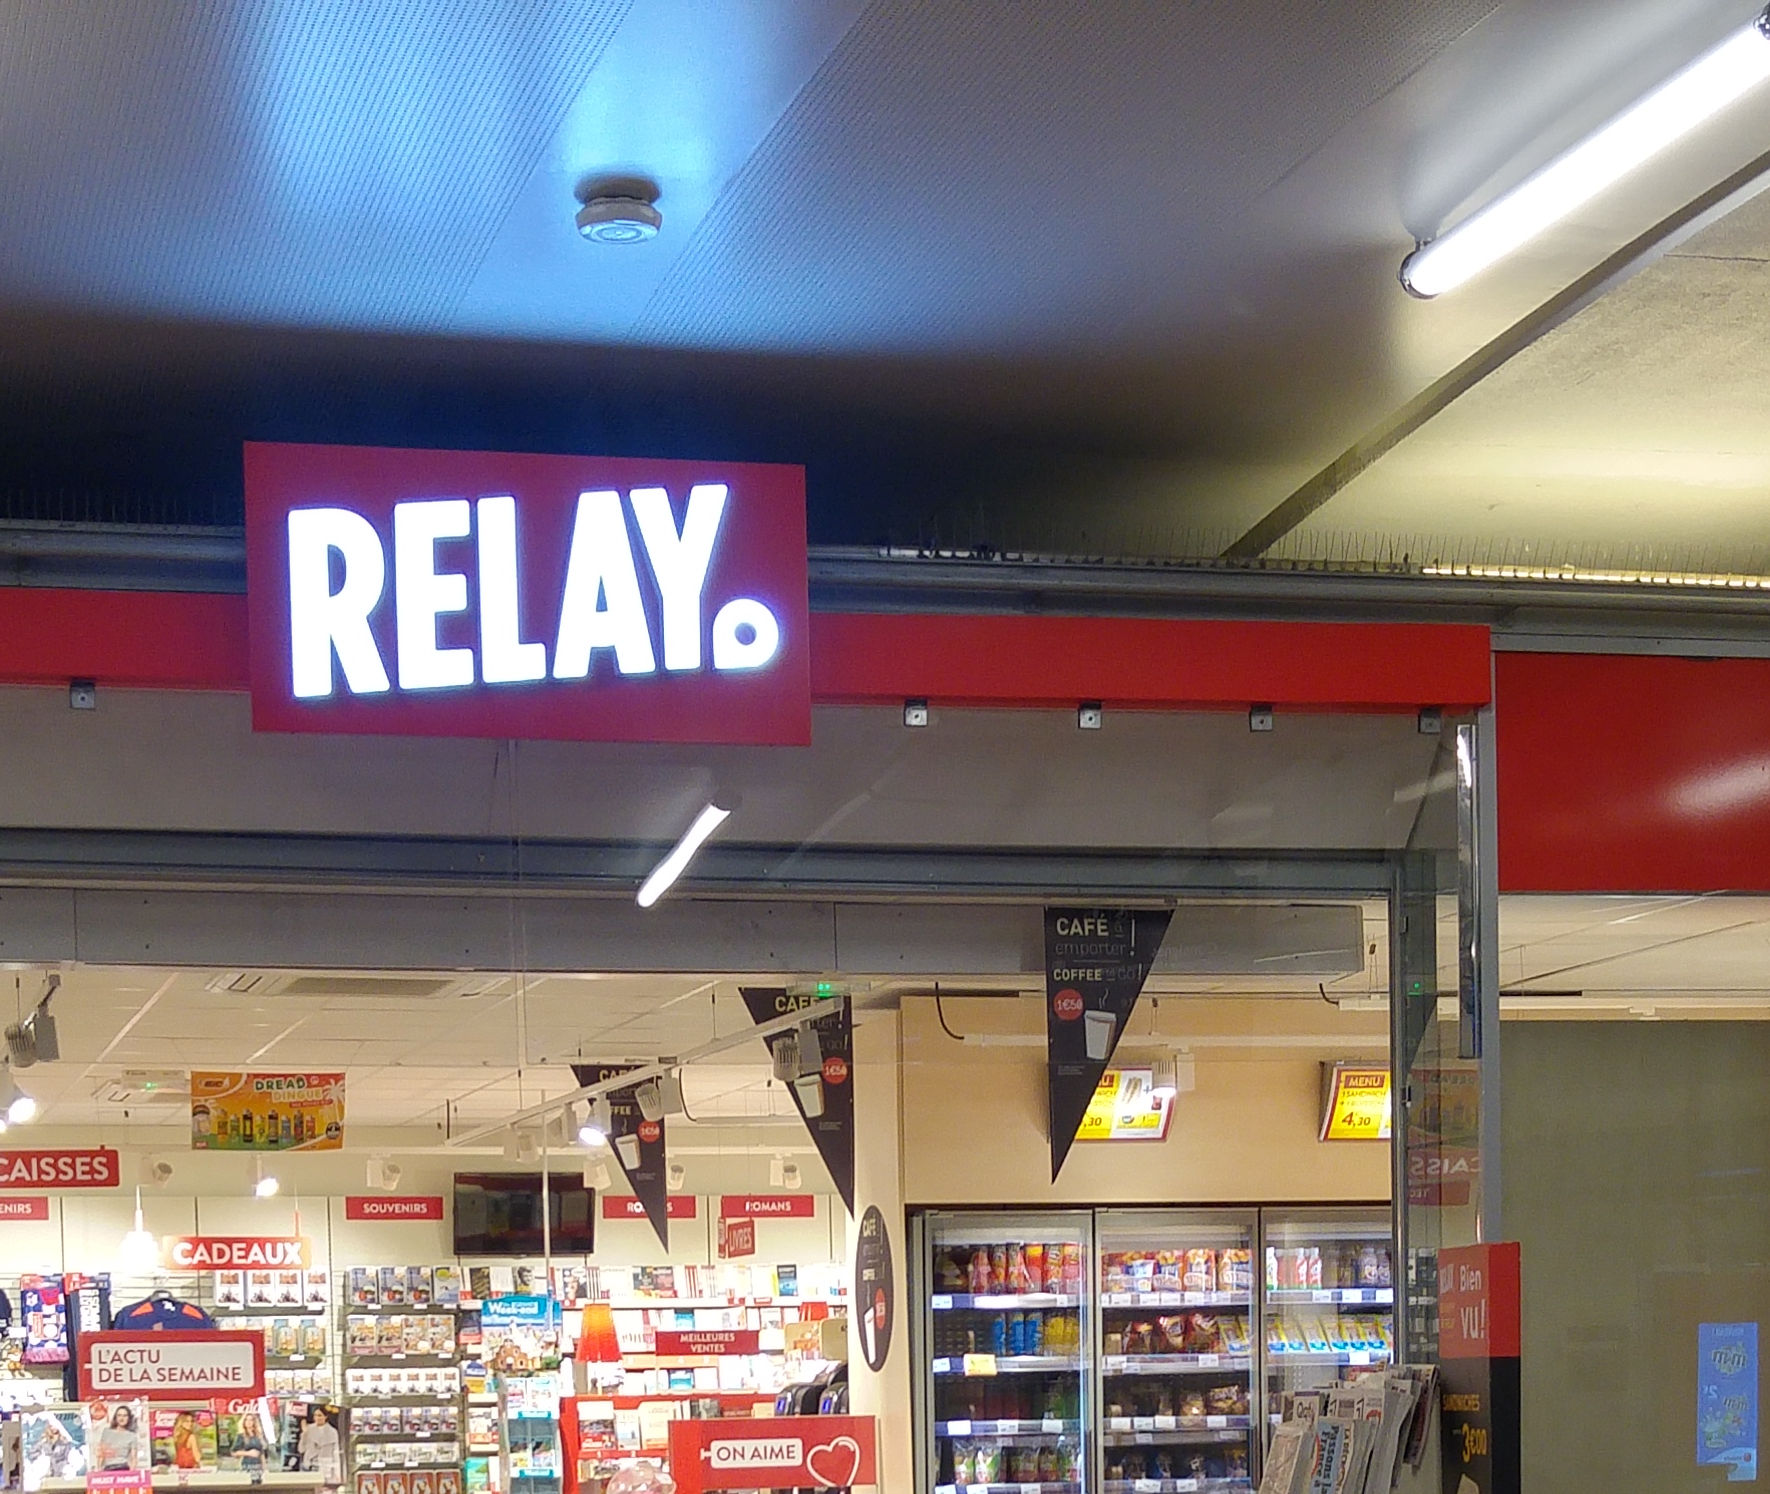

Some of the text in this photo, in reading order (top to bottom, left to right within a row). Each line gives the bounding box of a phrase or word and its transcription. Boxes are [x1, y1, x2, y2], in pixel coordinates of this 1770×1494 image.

[1056, 914, 1109, 936] CAFÉ
[1053, 968, 1102, 982] COFFEE
[255, 1075, 306, 1091] DREAD
[1348, 1076, 1381, 1087] MENU
[363, 1203, 428, 1214] SOUVENIRS
[627, 1202, 673, 1213] ROS
[172, 1242, 303, 1265] CADEAUX
[1459, 1264, 1482, 1292] Bien
[680, 1332, 736, 1343] MEILLEURES
[690, 1343, 725, 1353] VENTES
[98, 1349, 161, 1365] L'ACTU
[99, 1366, 242, 1383] DE LA SEMAINE
[716, 1444, 796, 1462] ON AIME
